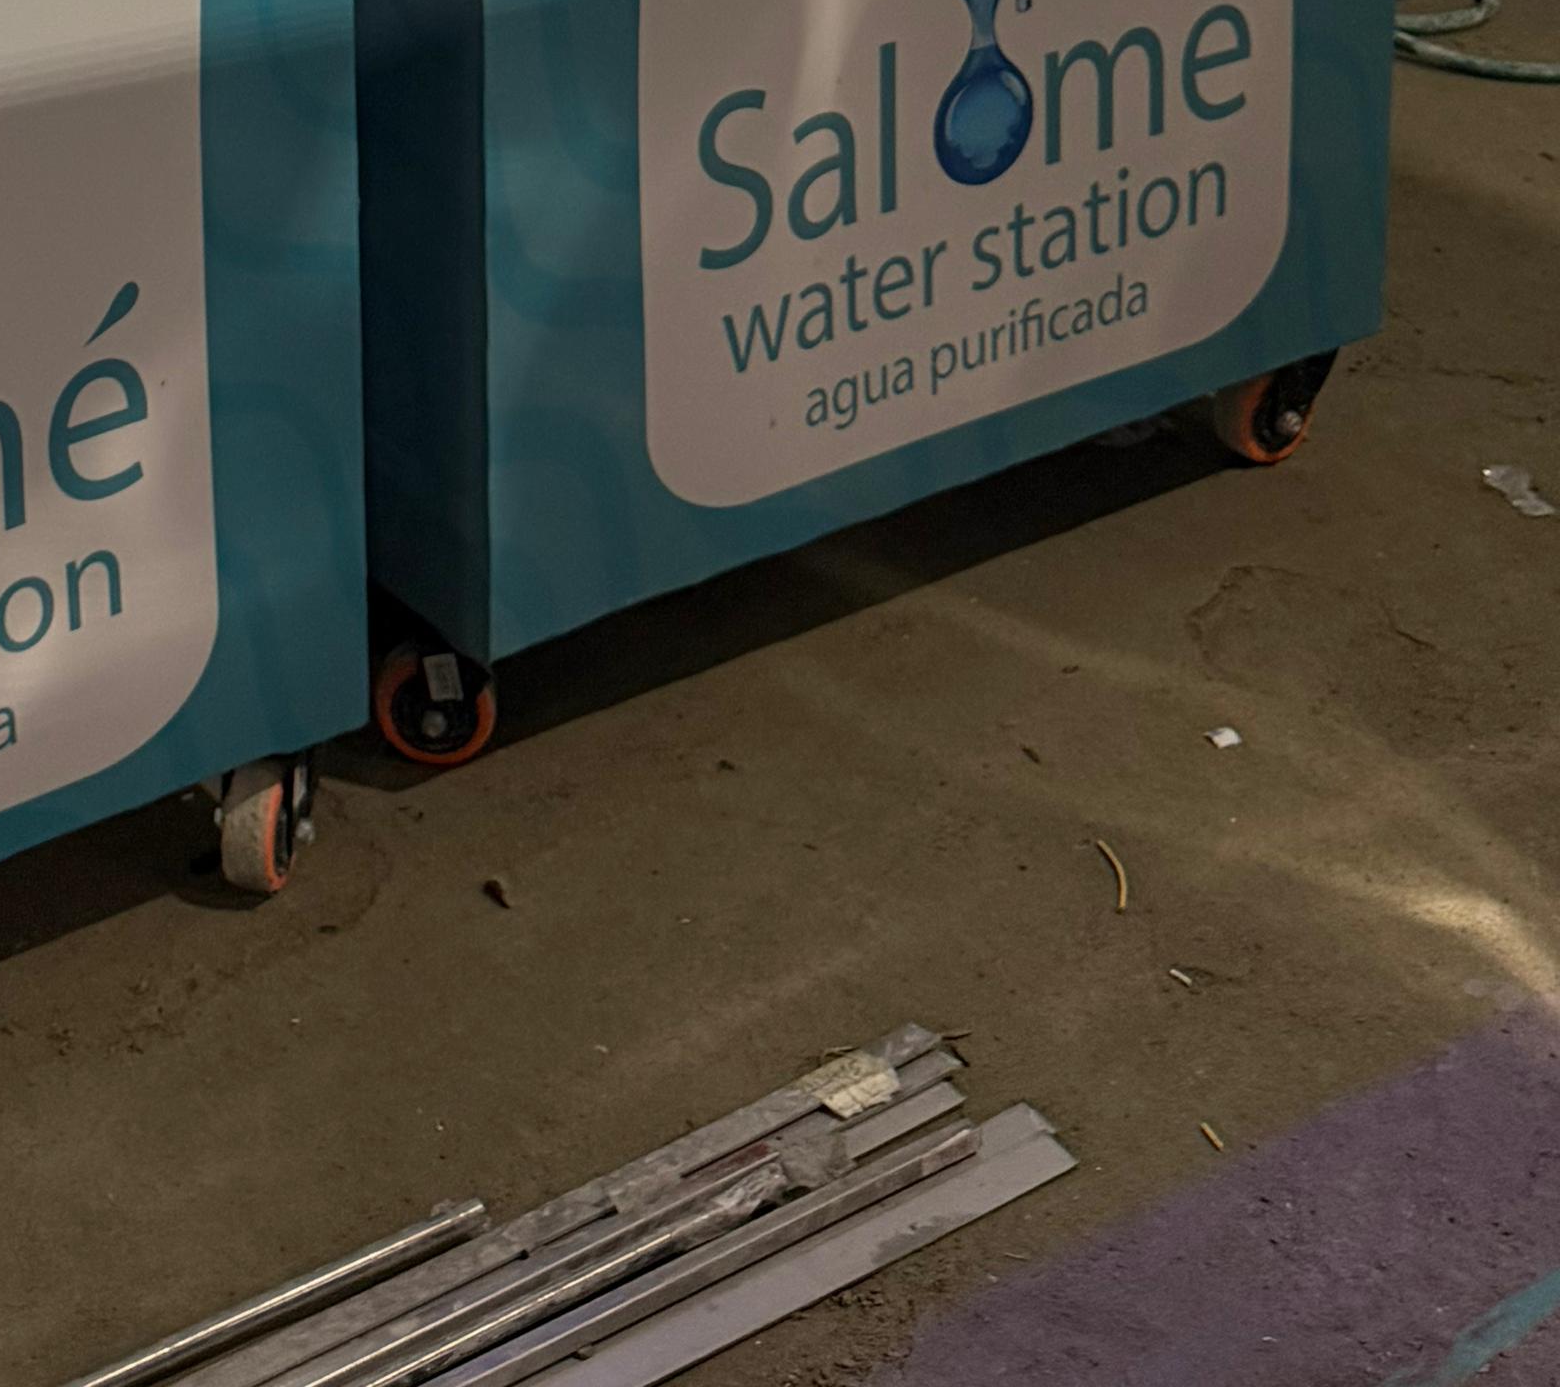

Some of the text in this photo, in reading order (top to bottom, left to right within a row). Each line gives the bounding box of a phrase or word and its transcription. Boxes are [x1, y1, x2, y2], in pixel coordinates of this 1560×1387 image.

[723, 160, 1227, 375] water station
[804, 273, 1149, 430] agua purificada
